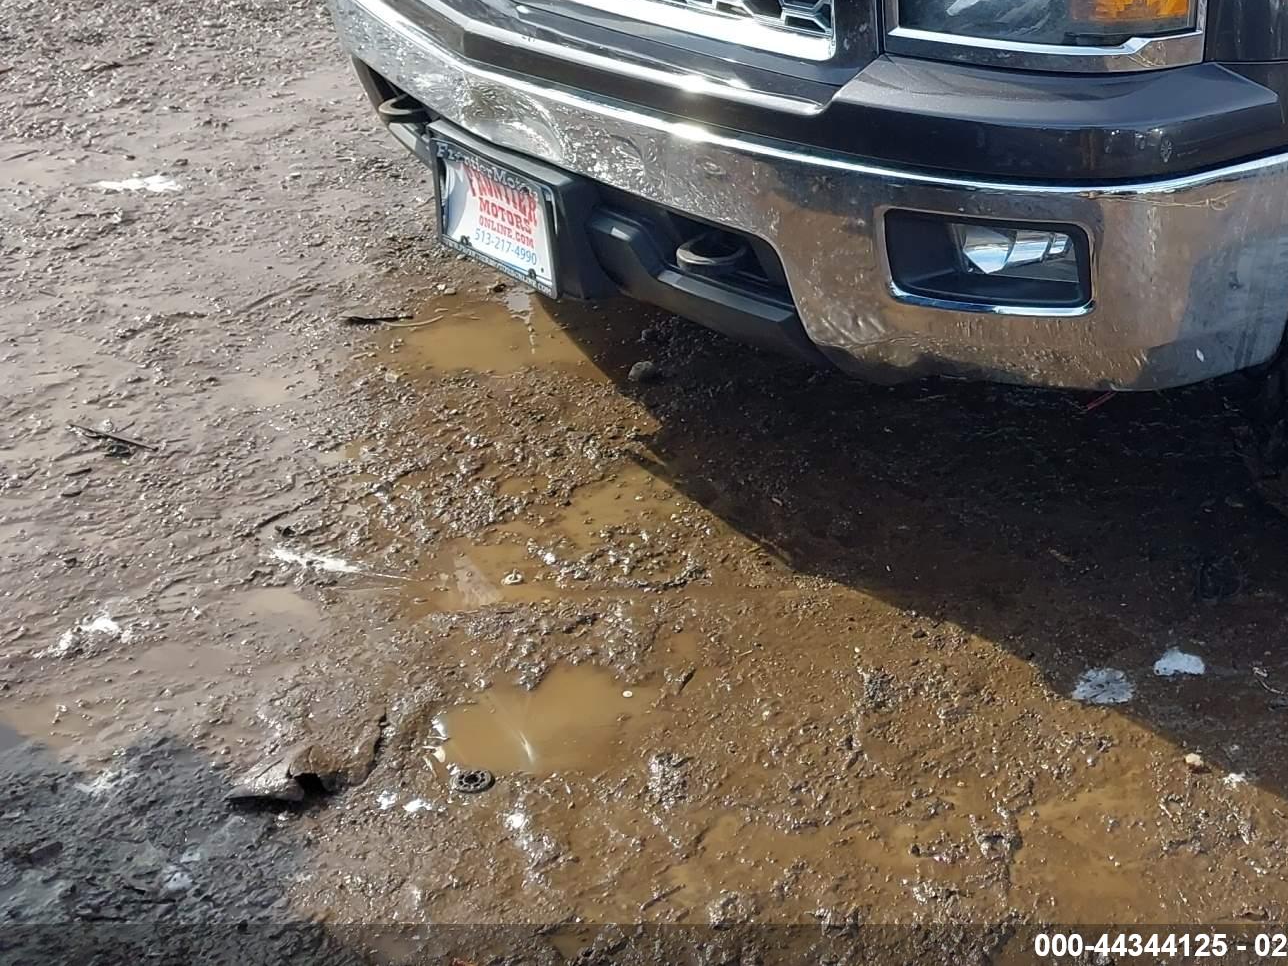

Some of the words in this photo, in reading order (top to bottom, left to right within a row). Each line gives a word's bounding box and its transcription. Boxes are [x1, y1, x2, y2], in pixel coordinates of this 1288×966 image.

[478, 216, 535, 249] ONLINE.COM
[479, 197, 532, 234] MOTORS
[474, 228, 538, 265] 513-217-4990
